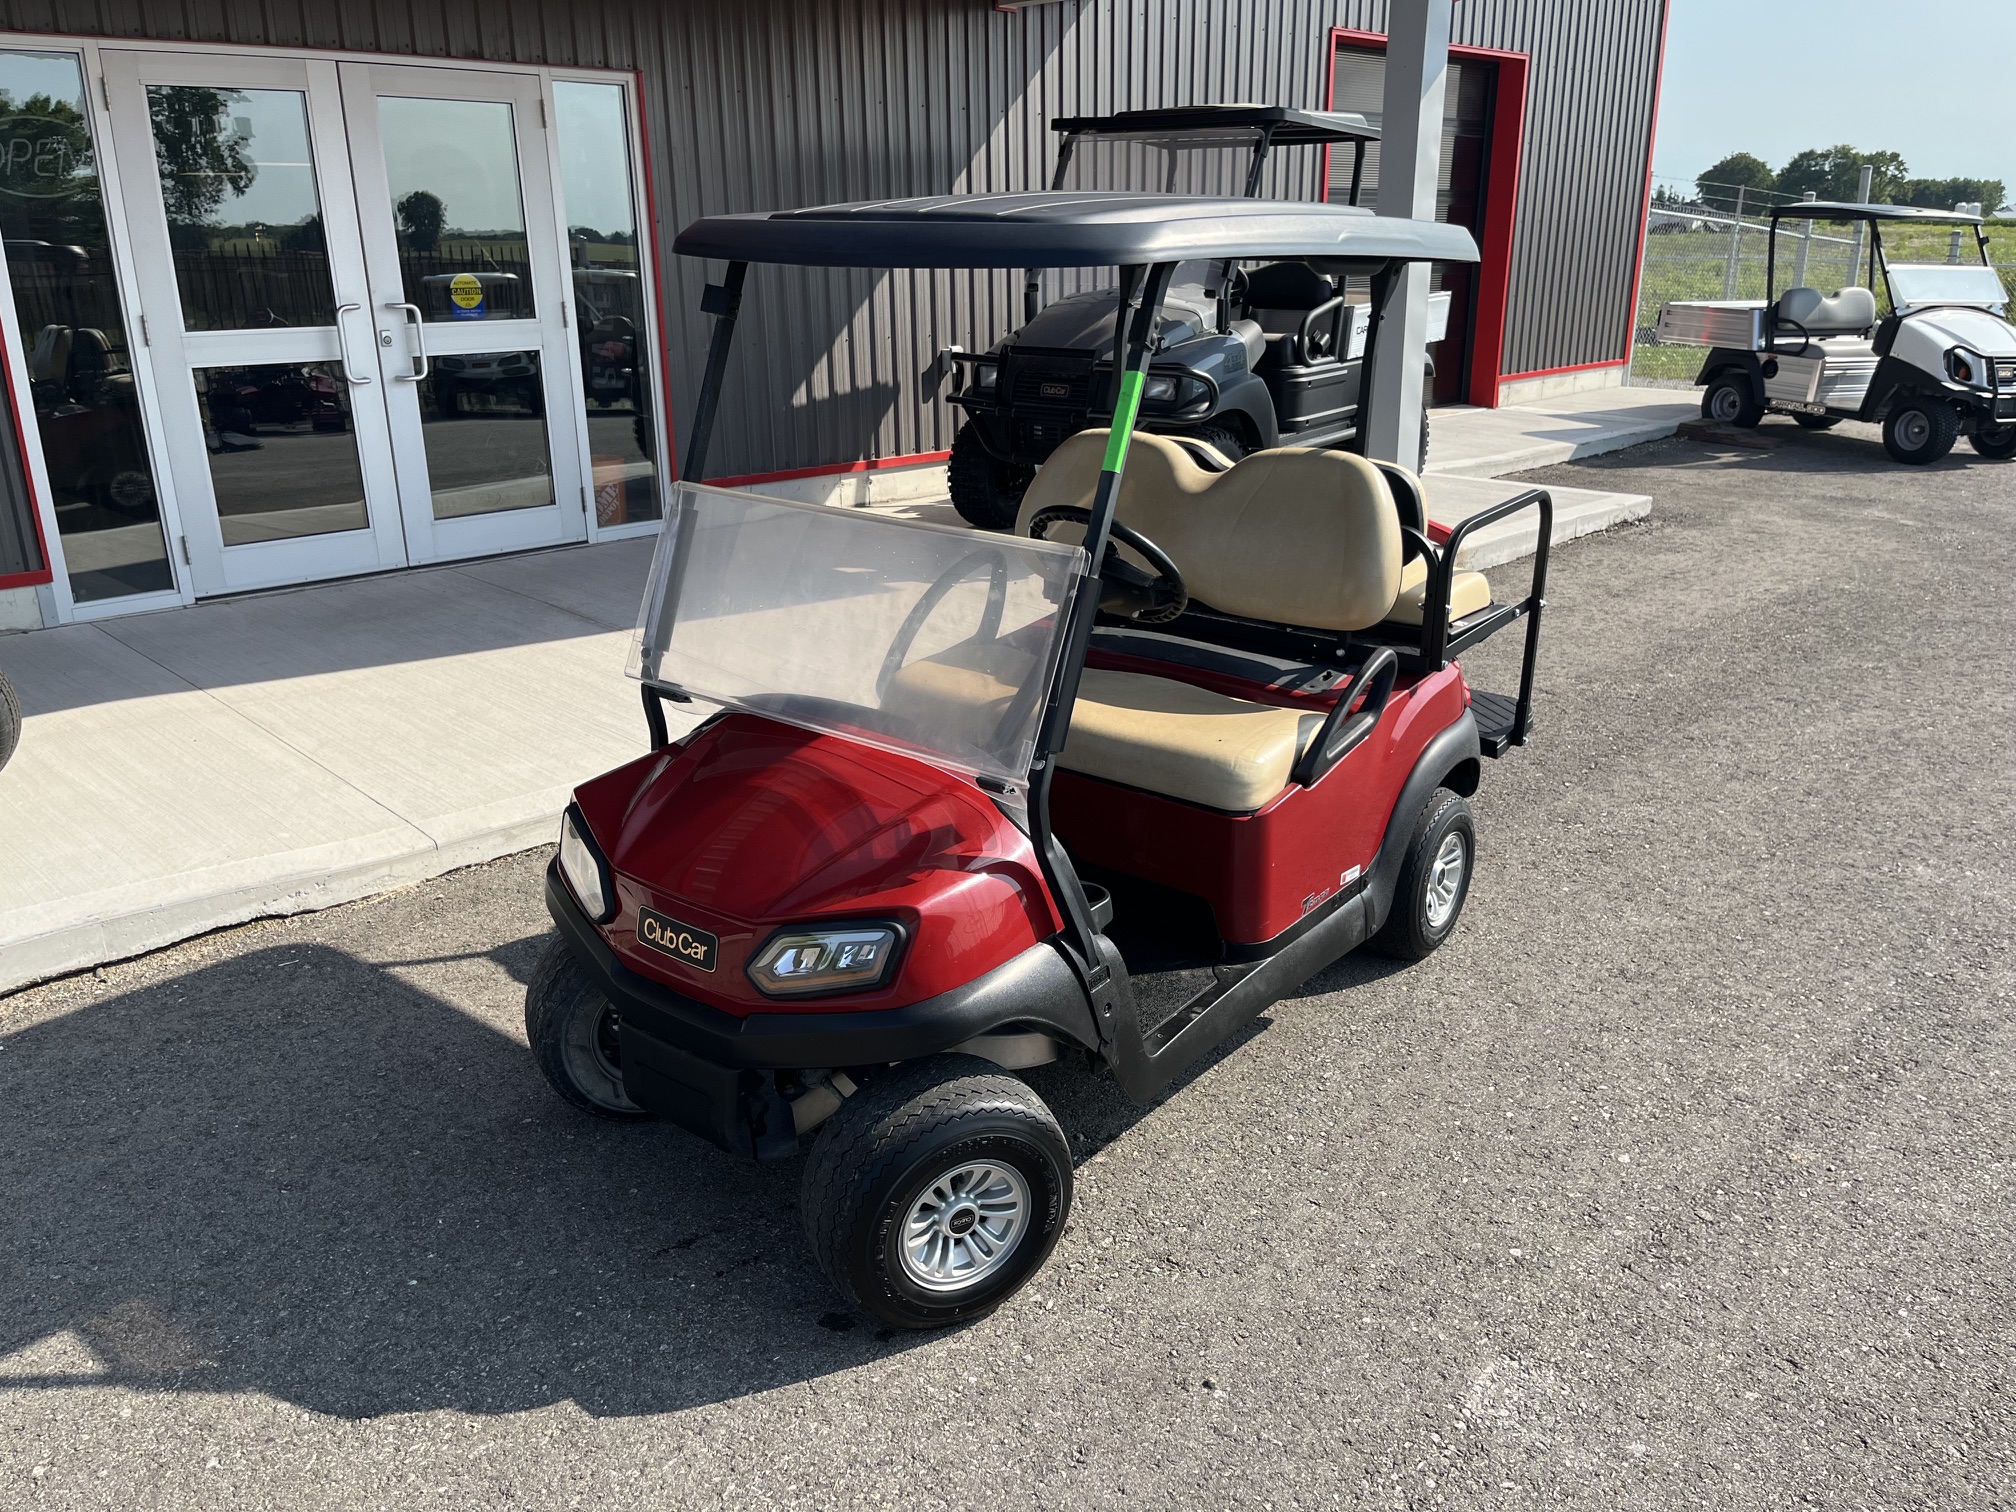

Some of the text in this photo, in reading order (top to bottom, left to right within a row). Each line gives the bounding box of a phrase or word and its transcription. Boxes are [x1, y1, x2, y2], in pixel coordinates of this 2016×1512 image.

[0, 137, 87, 176] PEN
[644, 917, 708, 960] Club Car
